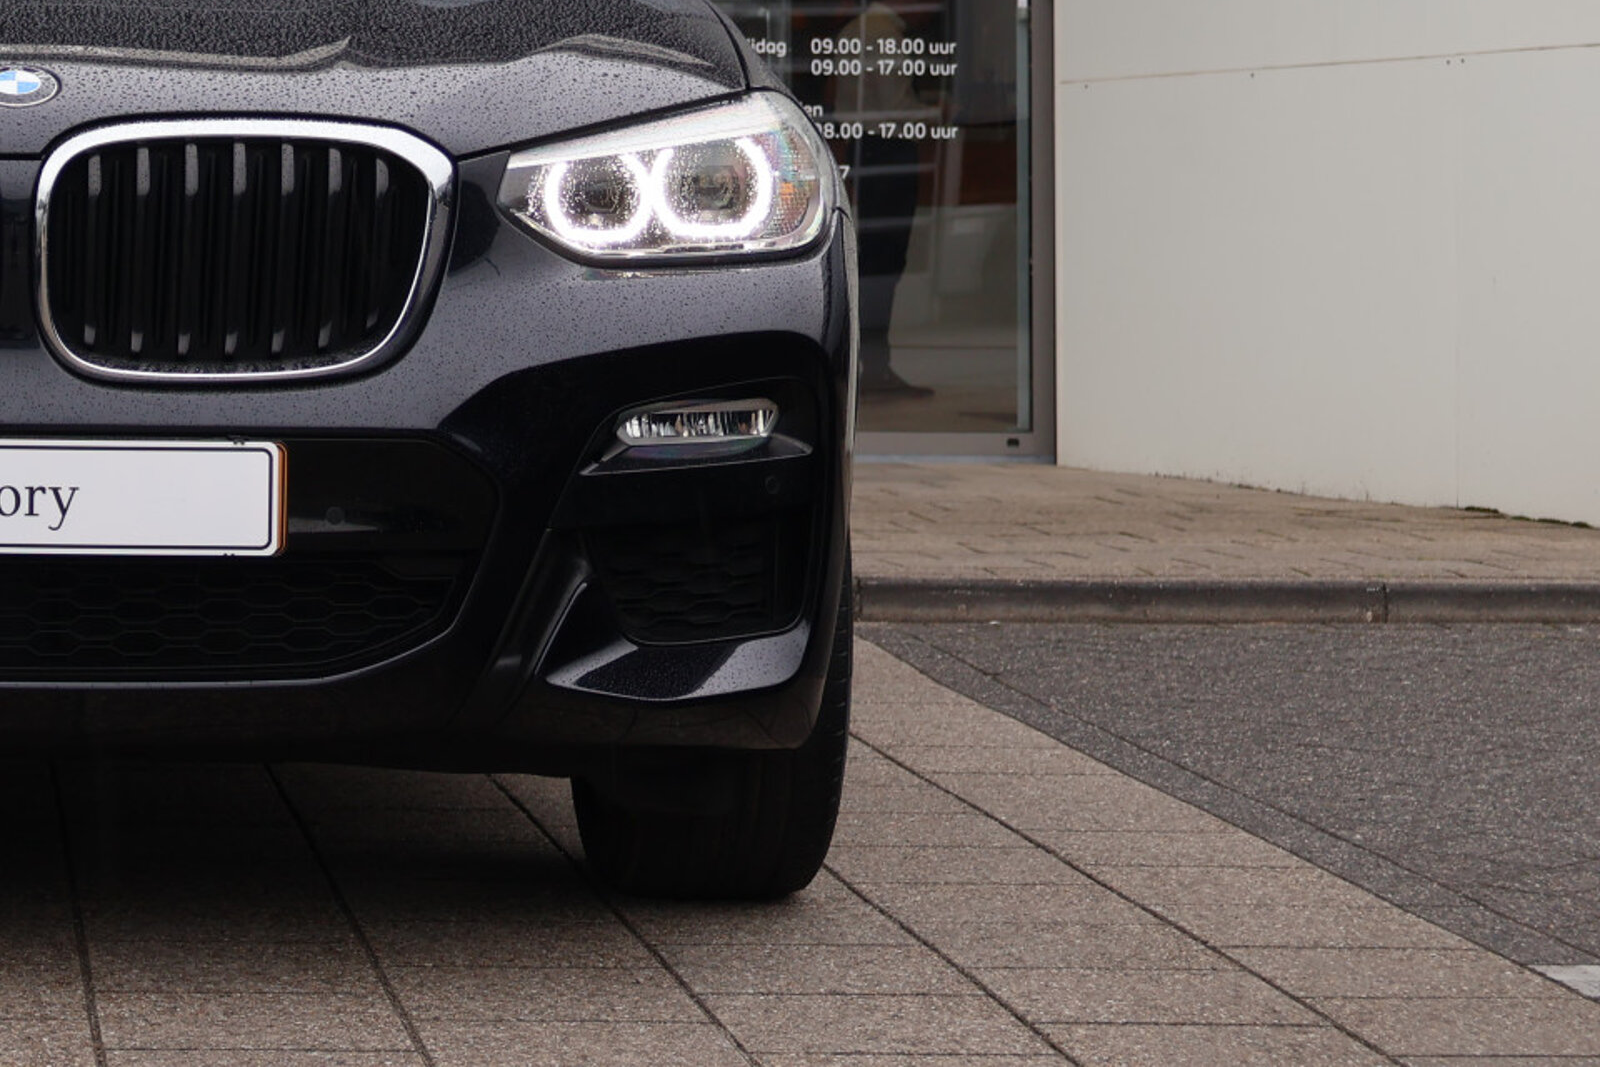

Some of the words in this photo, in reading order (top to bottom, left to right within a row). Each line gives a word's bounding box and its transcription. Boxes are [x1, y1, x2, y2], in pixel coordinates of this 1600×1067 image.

[810, 38, 861, 55] 09.00
[878, 38, 924, 55] 18.00
[929, 42, 957, 55] uur
[810, 59, 861, 76] 09.00
[878, 59, 925, 76] 17.00
[929, 63, 957, 76] uur
[879, 122, 925, 139] 17.00
[930, 127, 958, 139] uur
